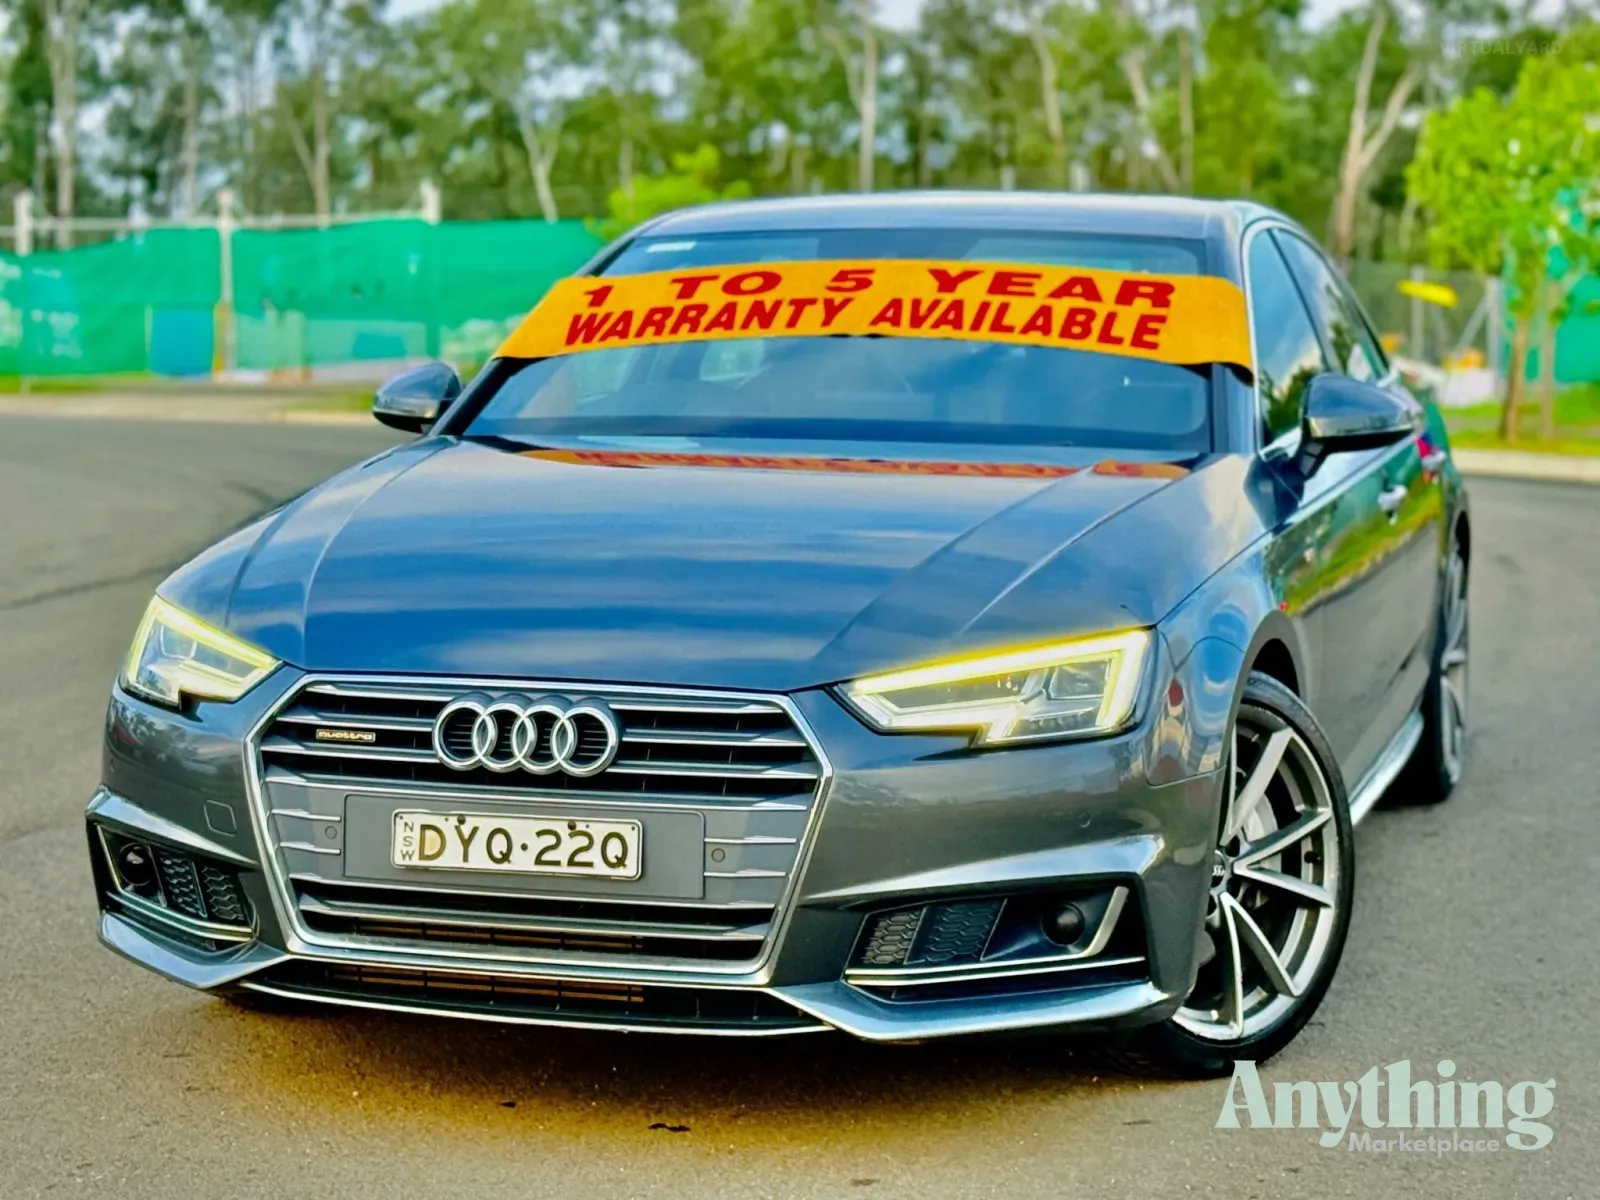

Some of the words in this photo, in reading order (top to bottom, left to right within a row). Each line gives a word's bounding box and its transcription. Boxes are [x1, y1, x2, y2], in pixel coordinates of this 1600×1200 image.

[583, 284, 613, 308] 1
[669, 270, 783, 301] TO
[825, 268, 876, 293] 5
[927, 267, 1176, 309] YEAR
[564, 296, 856, 347] WARRANTY
[868, 296, 1168, 351] AVAILABLE
